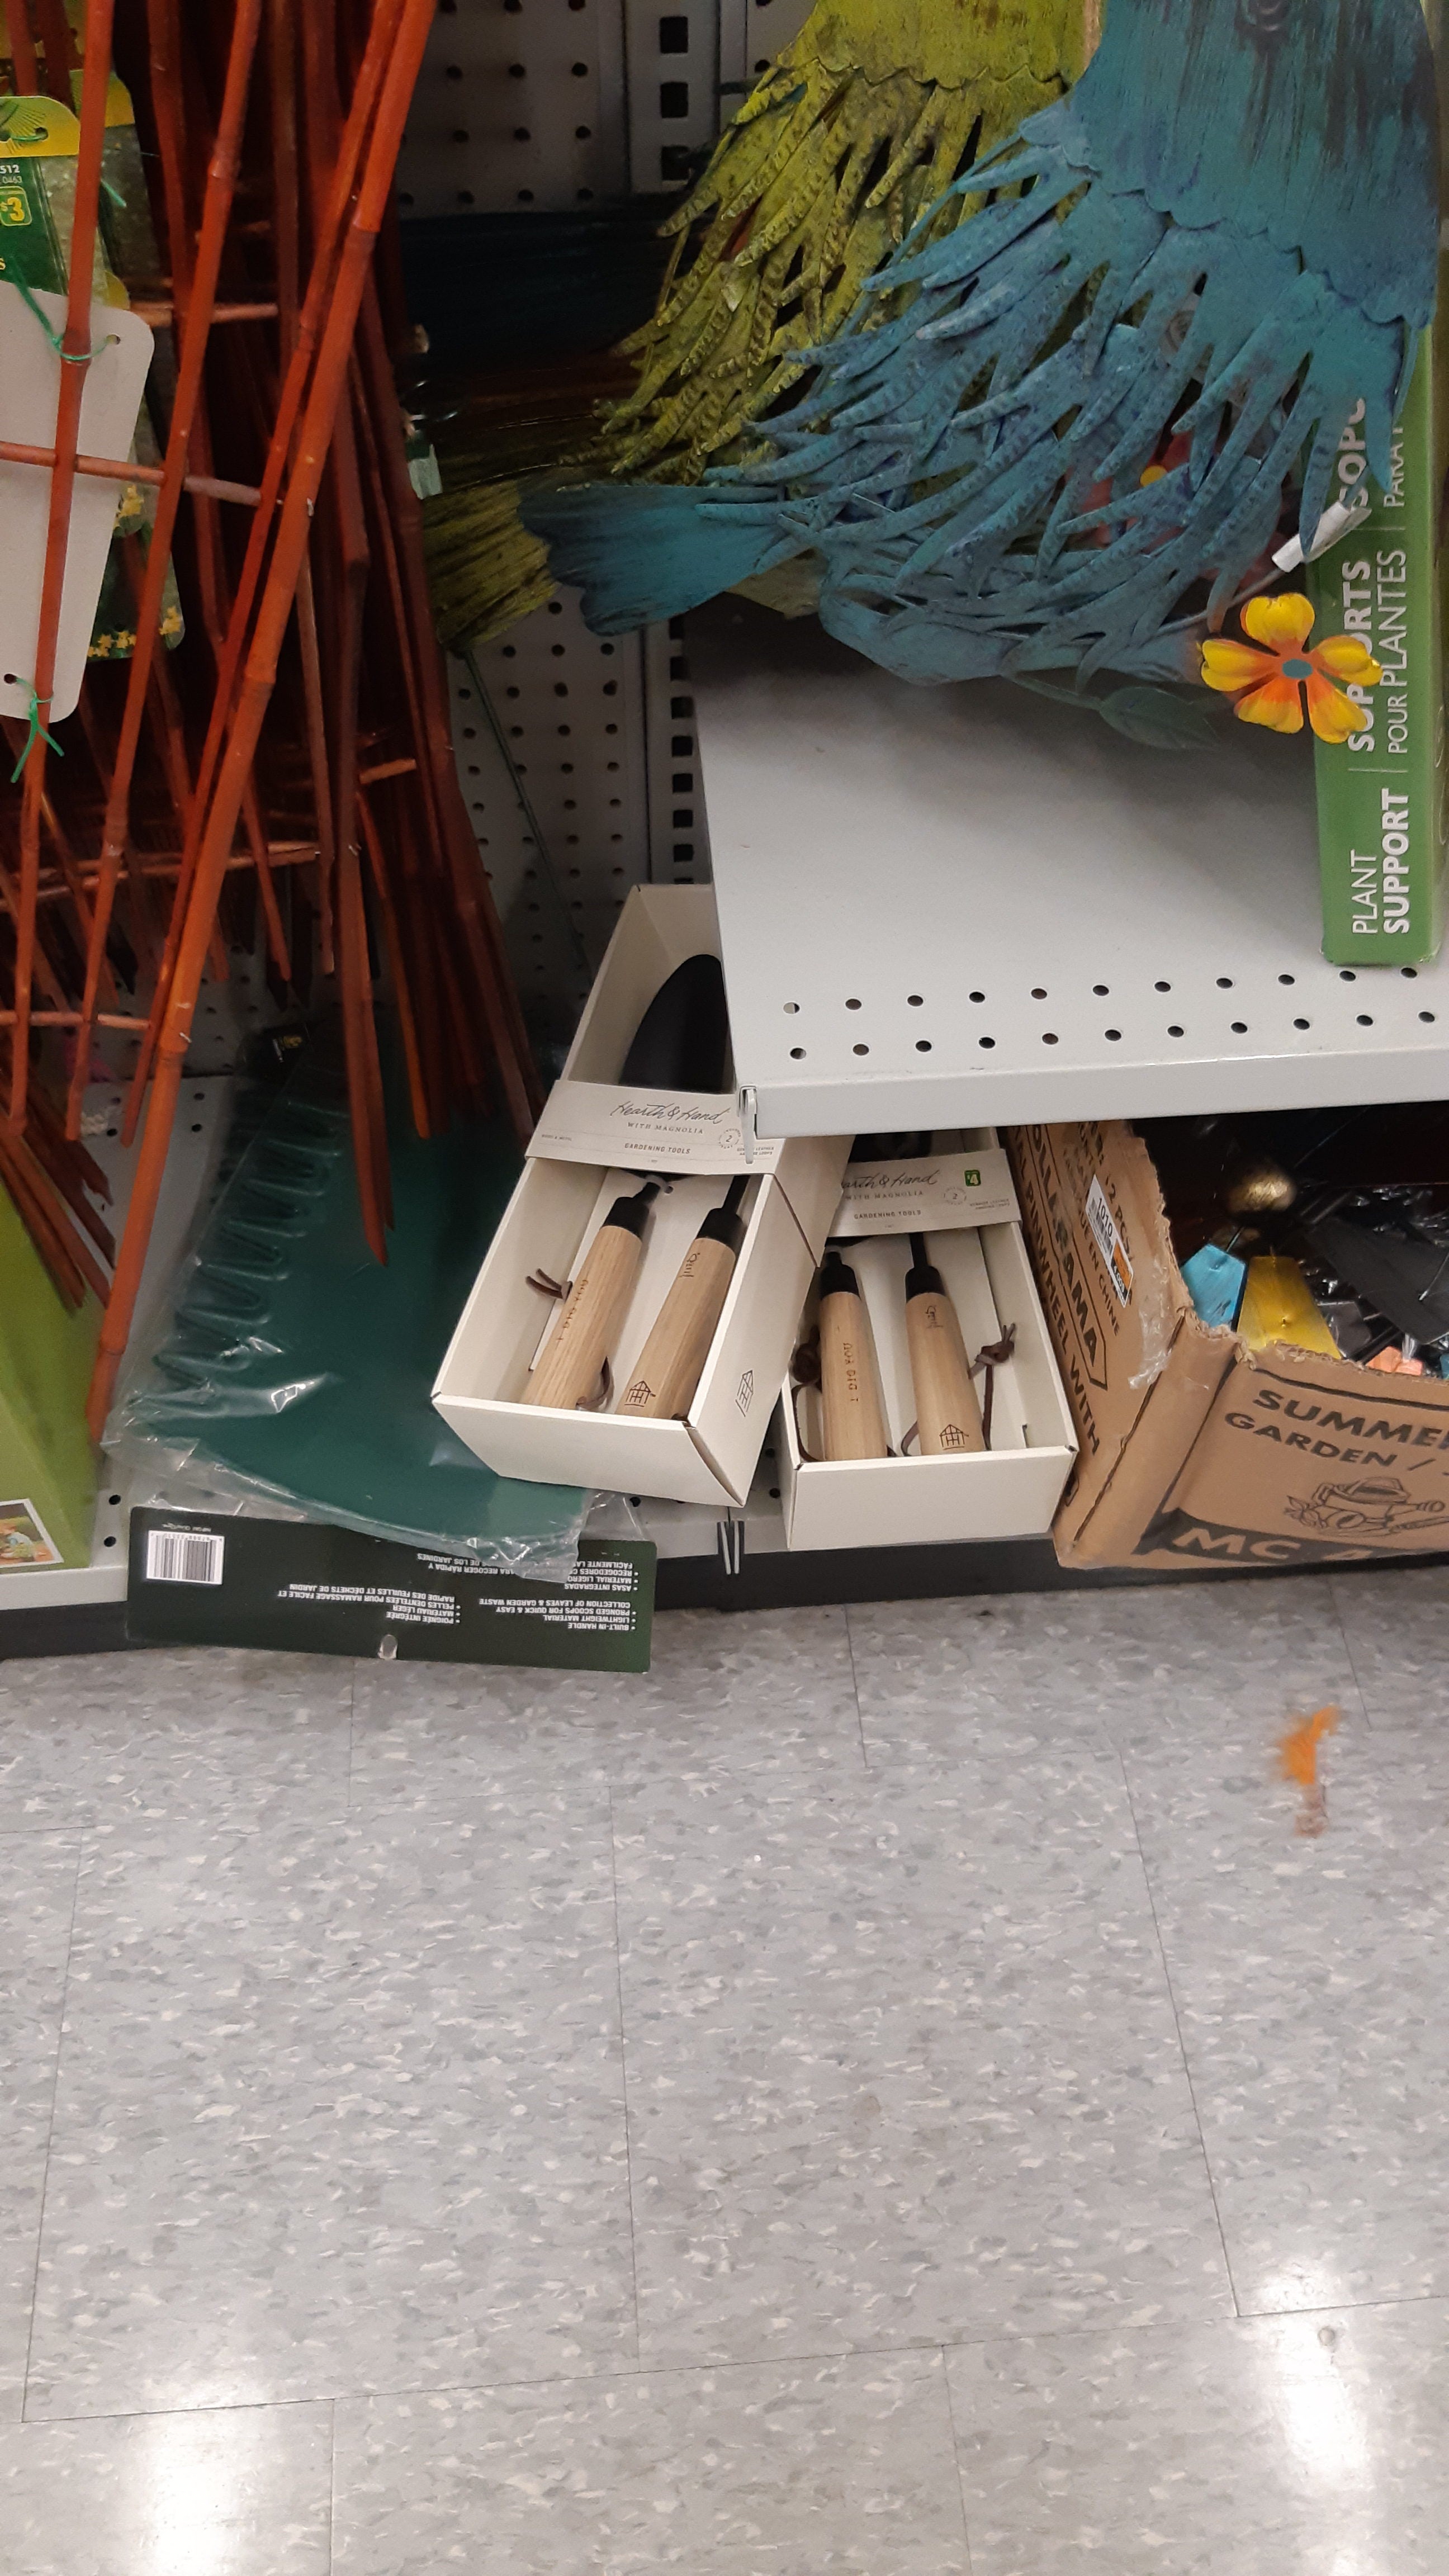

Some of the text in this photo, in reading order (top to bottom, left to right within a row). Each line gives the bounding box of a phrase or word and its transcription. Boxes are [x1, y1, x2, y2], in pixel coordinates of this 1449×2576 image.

[1376, 550, 1408, 753] POUR PLANTES
[1381, 788, 1410, 934] SUPPORT
[1350, 849, 1378, 934] PLANT
[610, 1101, 731, 1125] Hearth & Hand
[627, 1121, 703, 1134] WITH MAGNOLIA
[624, 1143, 691, 1154] GARDENING TOOLS
[891, 1169, 940, 1188] Hand
[874, 1190, 923, 1199] MAGNOLIA
[854, 1211, 896, 1220] GARDENING
[1097, 1197, 1113, 1238] 1010
[843, 1343, 854, 1365] YOU
[1070, 1354, 1100, 1456] WITH
[1252, 1389, 1449, 1450] SUMME
[1224, 1412, 1398, 1467] GARDEN
[417, 1553, 452, 1563] JARDINES
[434, 1564, 462, 1573] RÁPIDA
[332, 1586, 364, 1595] DÉCHETS
[377, 1589, 410, 1598] FEUILLES
[316, 1593, 362, 1602] RAMASSAGE
[386, 1597, 426, 1607] DENTELÉES
[428, 1594, 455, 1603] RAPIDE
[428, 1602, 454, 1610] PELLES
[386, 1612, 454, 1625] POIGNÉE INTÉGRÉE
[417, 1608, 454, 1617] MATÉRIAU
